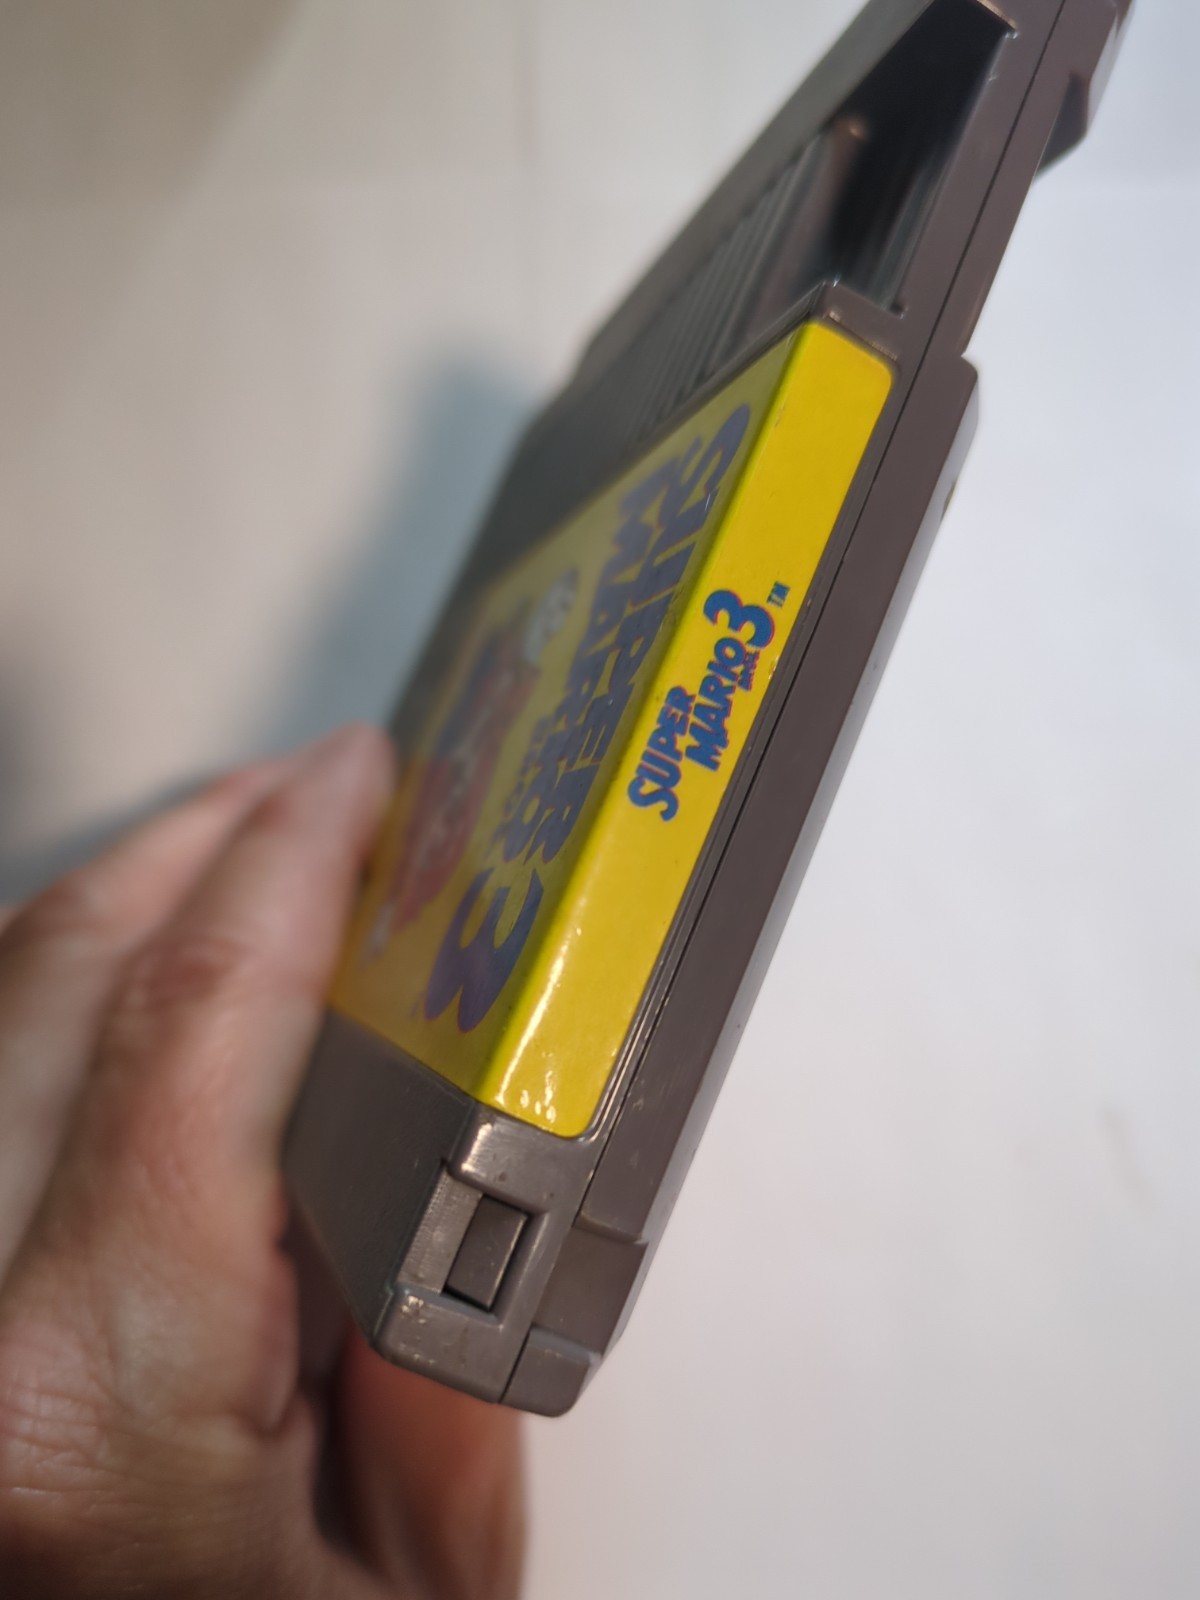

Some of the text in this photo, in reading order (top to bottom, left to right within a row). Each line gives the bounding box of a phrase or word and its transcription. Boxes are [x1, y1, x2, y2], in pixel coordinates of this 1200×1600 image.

[504, 448, 690, 862] MARIO
[523, 402, 753, 864] SUPER
[703, 589, 775, 651] 3
[627, 685, 696, 822] SUPER
[685, 637, 747, 772] MARIO
[424, 868, 543, 1033] 3
